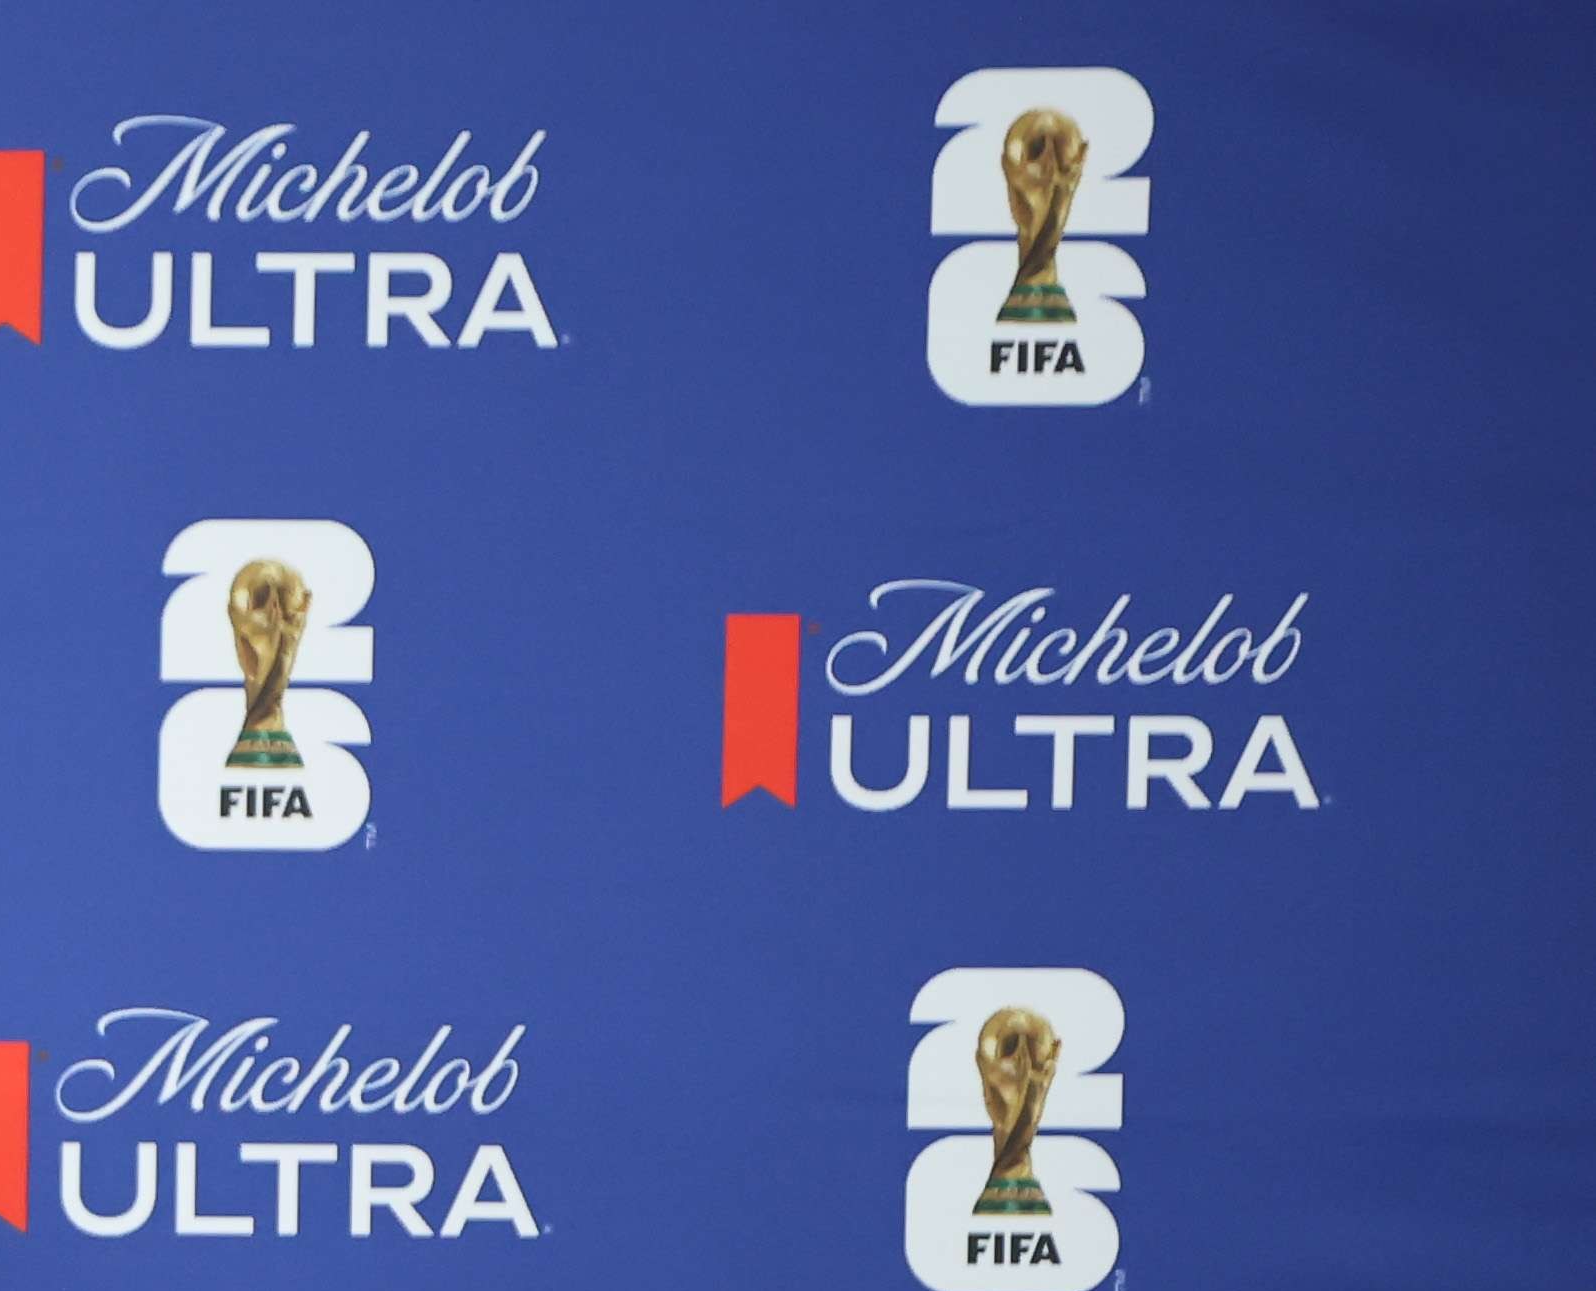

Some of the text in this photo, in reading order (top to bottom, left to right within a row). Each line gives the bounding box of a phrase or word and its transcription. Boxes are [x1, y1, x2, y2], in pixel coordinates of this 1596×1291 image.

[70, 116, 545, 232] Michelob
[75, 252, 557, 349] ULTRA
[990, 341, 1085, 373] FIFA
[826, 580, 1308, 695] Michelob
[220, 786, 312, 818] FIFA
[830, 715, 1319, 812] ULTRA
[55, 1008, 525, 1122] Michelob
[60, 1142, 539, 1237] ULTRA
[967, 1233, 1061, 1265] FIFA
